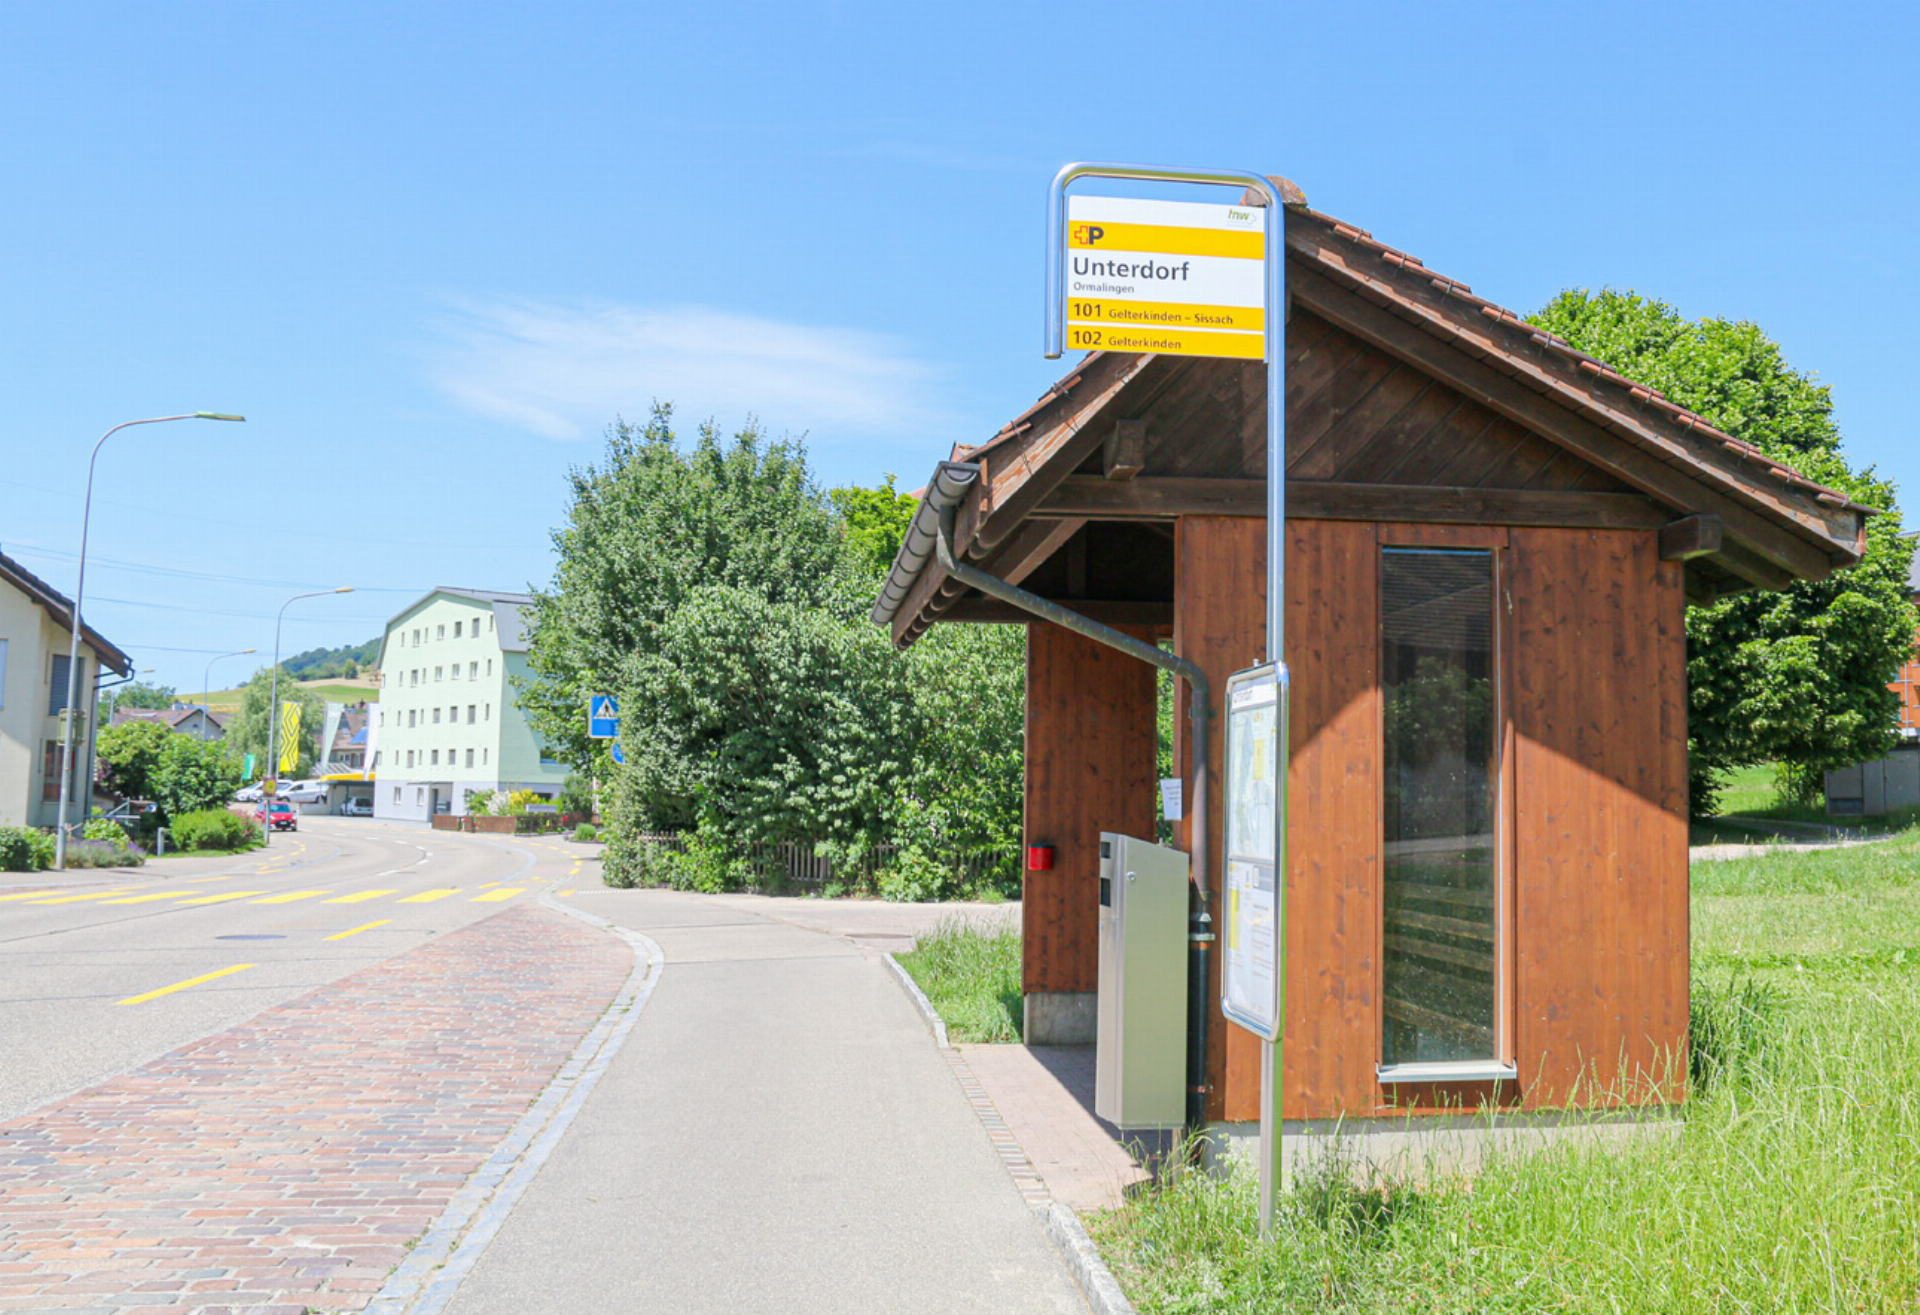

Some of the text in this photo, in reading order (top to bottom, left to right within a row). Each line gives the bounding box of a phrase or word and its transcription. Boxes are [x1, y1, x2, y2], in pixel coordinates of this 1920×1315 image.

[1073, 256, 1190, 281] Unterdorf
[1073, 281, 1135, 295] Ormalingen
[1073, 303, 1102, 317] 101
[1108, 308, 1182, 322] Gelterkinden
[1194, 313, 1233, 325] Sissach
[1073, 330, 1182, 349] 102 Gelterkinden
